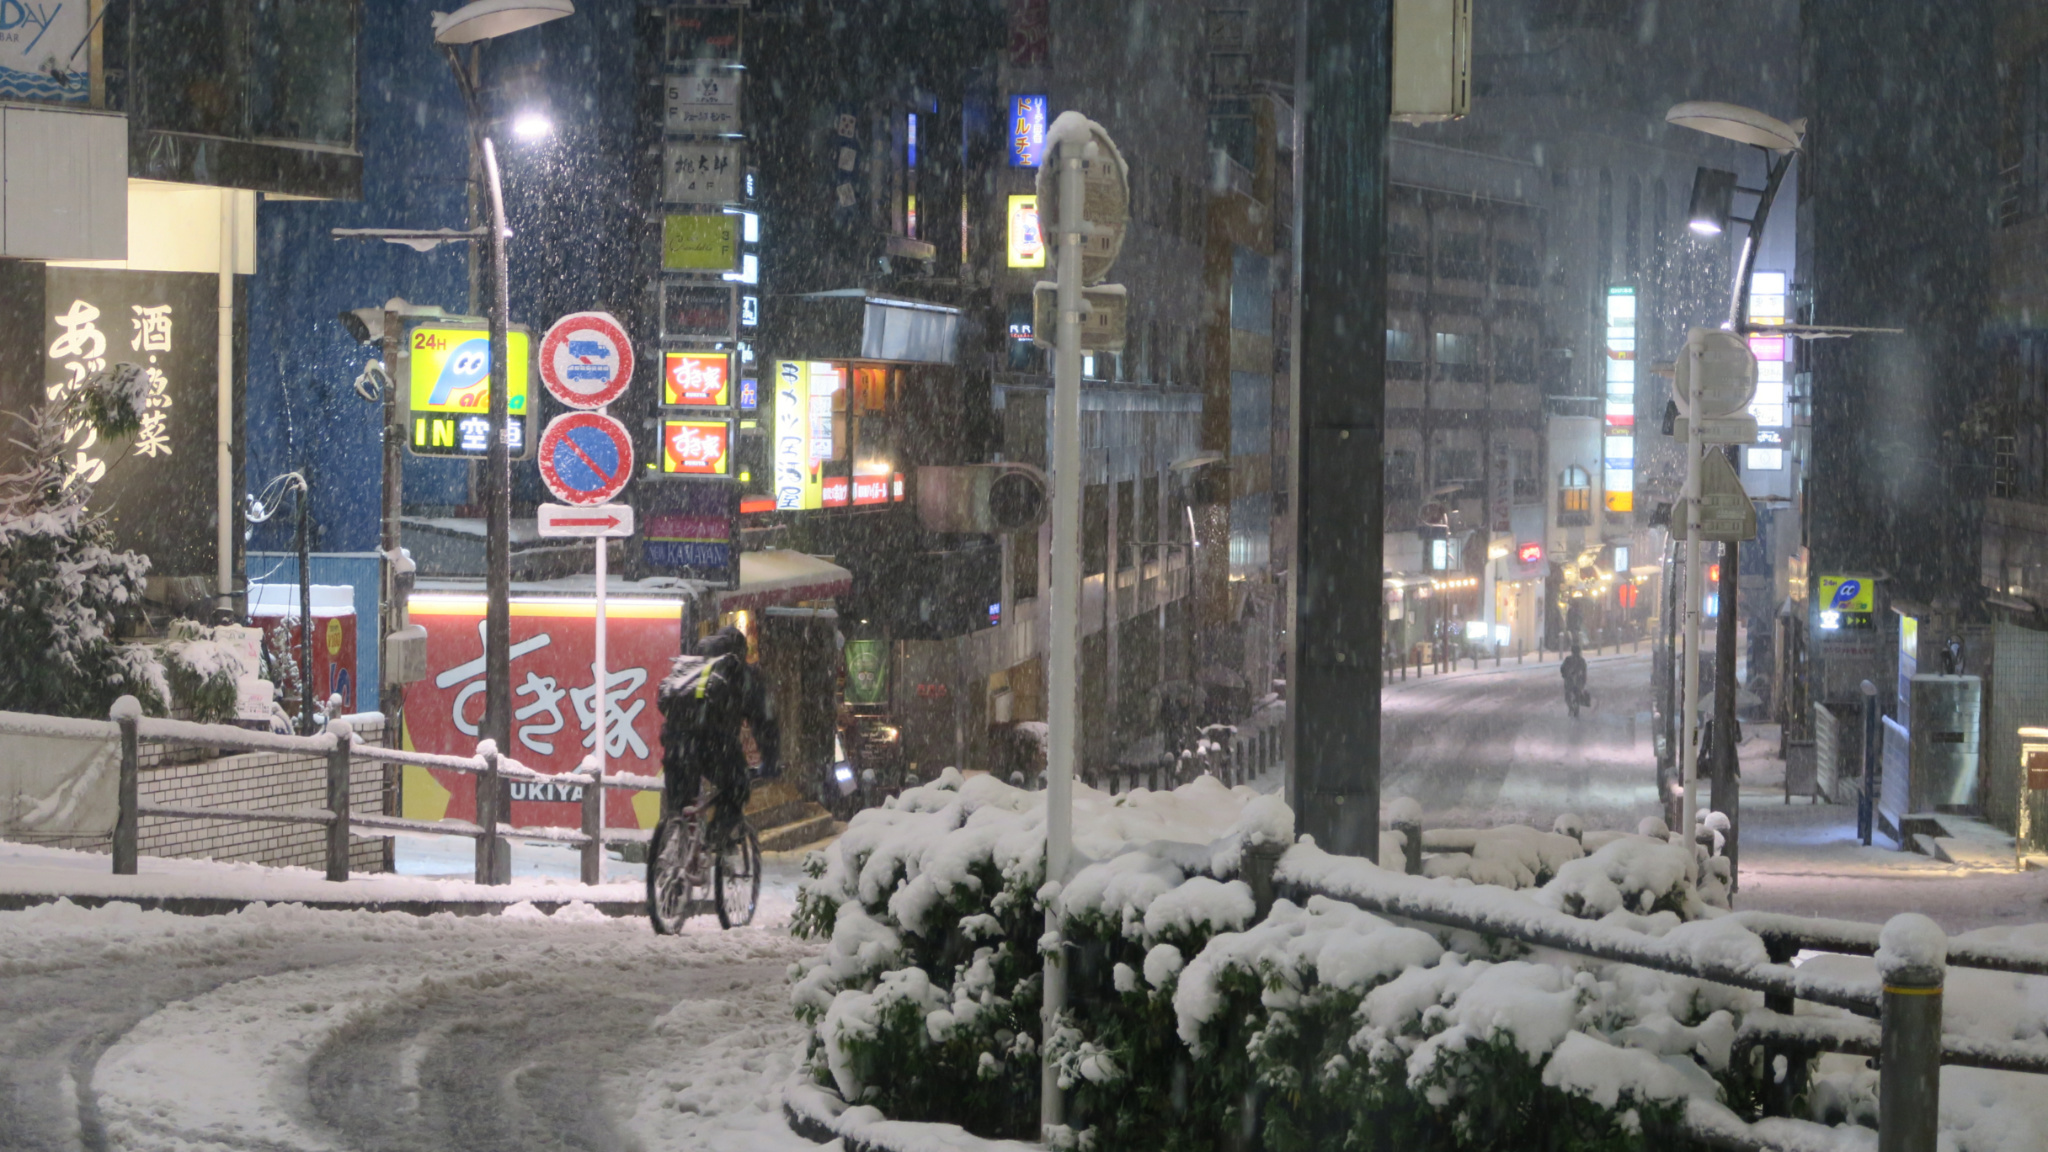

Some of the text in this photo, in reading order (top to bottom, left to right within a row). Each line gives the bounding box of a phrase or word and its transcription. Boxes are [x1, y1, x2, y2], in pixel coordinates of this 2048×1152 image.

[0, 33, 19, 42] BAR
[1015, 97, 1032, 166] ドルチェ
[414, 333, 446, 350] 24H
[673, 358, 721, 392] すき家
[415, 418, 454, 447] IN
[672, 426, 720, 460] すき家
[436, 618, 650, 775] すき家
[511, 783, 583, 801] UKIYA
